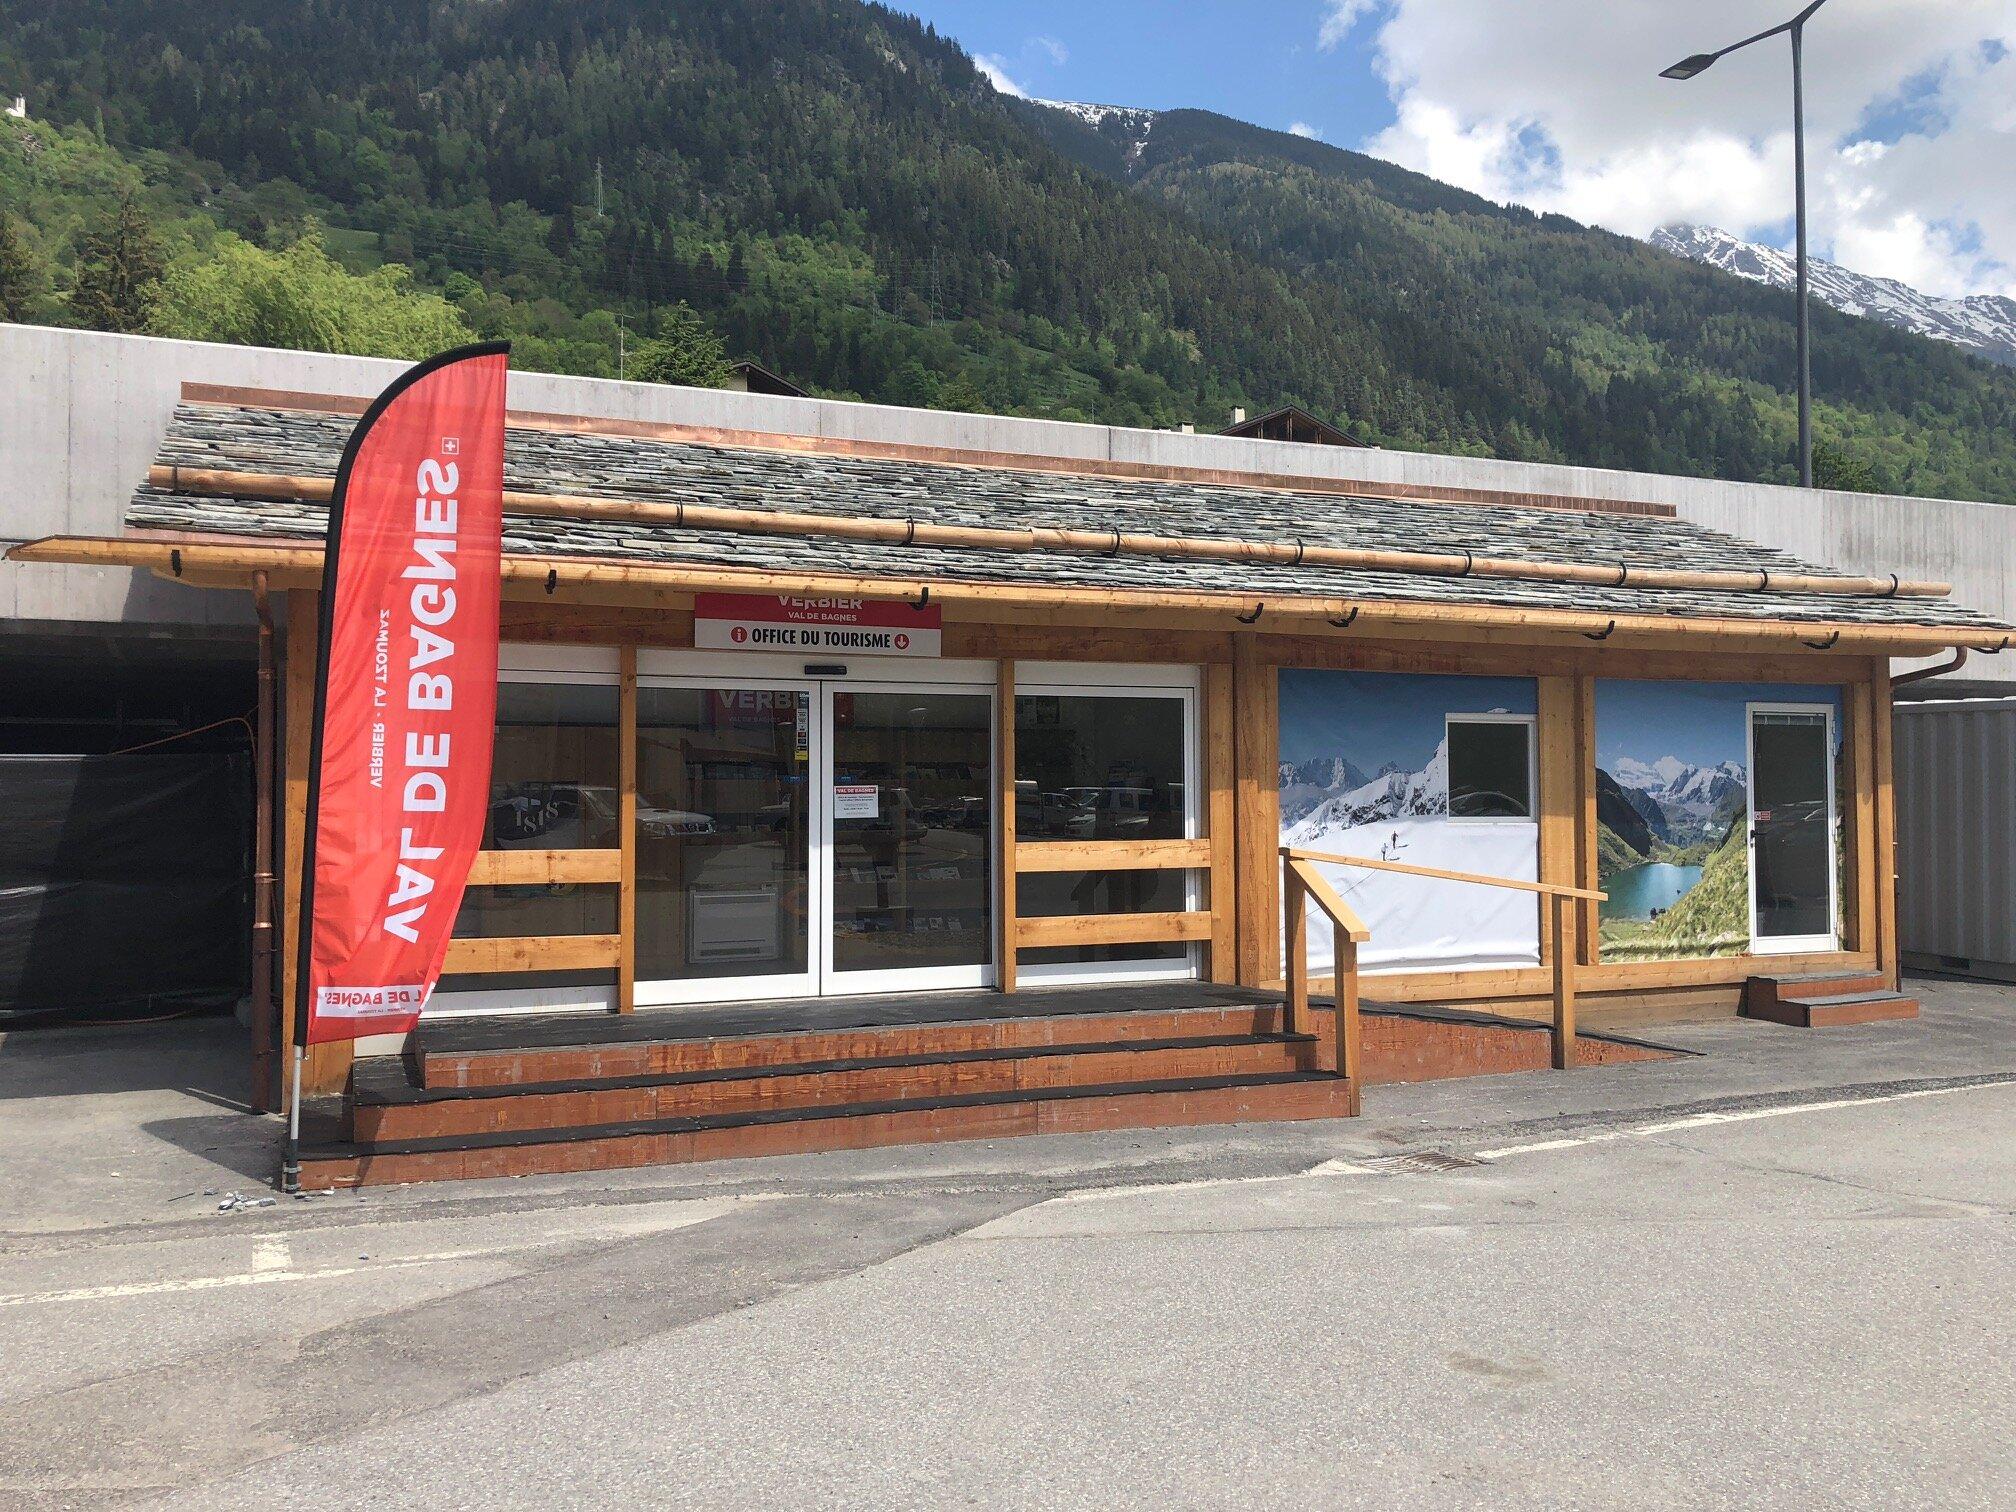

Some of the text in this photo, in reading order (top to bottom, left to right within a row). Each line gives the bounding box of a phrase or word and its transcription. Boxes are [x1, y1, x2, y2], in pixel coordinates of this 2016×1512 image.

[778, 595, 863, 610] VERBIER
[788, 611, 857, 622] VAL DE BAGNES
[752, 628, 891, 648] OFFICE DU TOURISME
